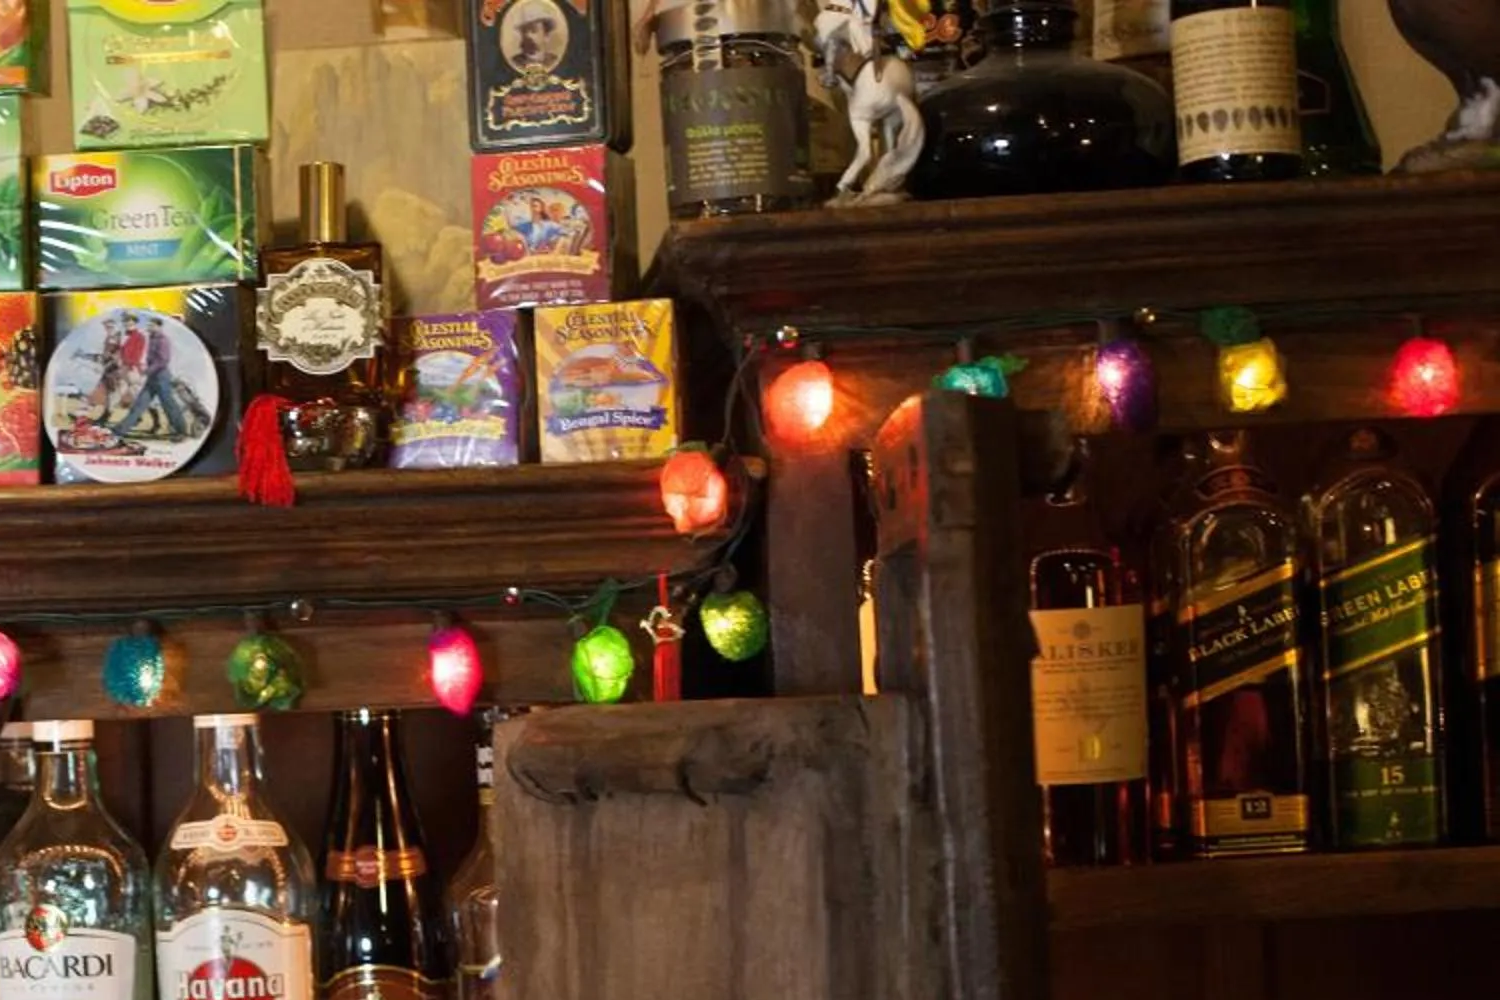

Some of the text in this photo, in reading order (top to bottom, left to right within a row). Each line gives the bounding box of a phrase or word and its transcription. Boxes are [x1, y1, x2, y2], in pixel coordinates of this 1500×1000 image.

[53, 174, 113, 196] Lipton
[90, 207, 159, 230] Green
[1332, 570, 1428, 621] REEN LABE
[1380, 766, 1406, 786] 15
[0, 953, 114, 980] BACARDI
[176, 970, 285, 1000] Havana
